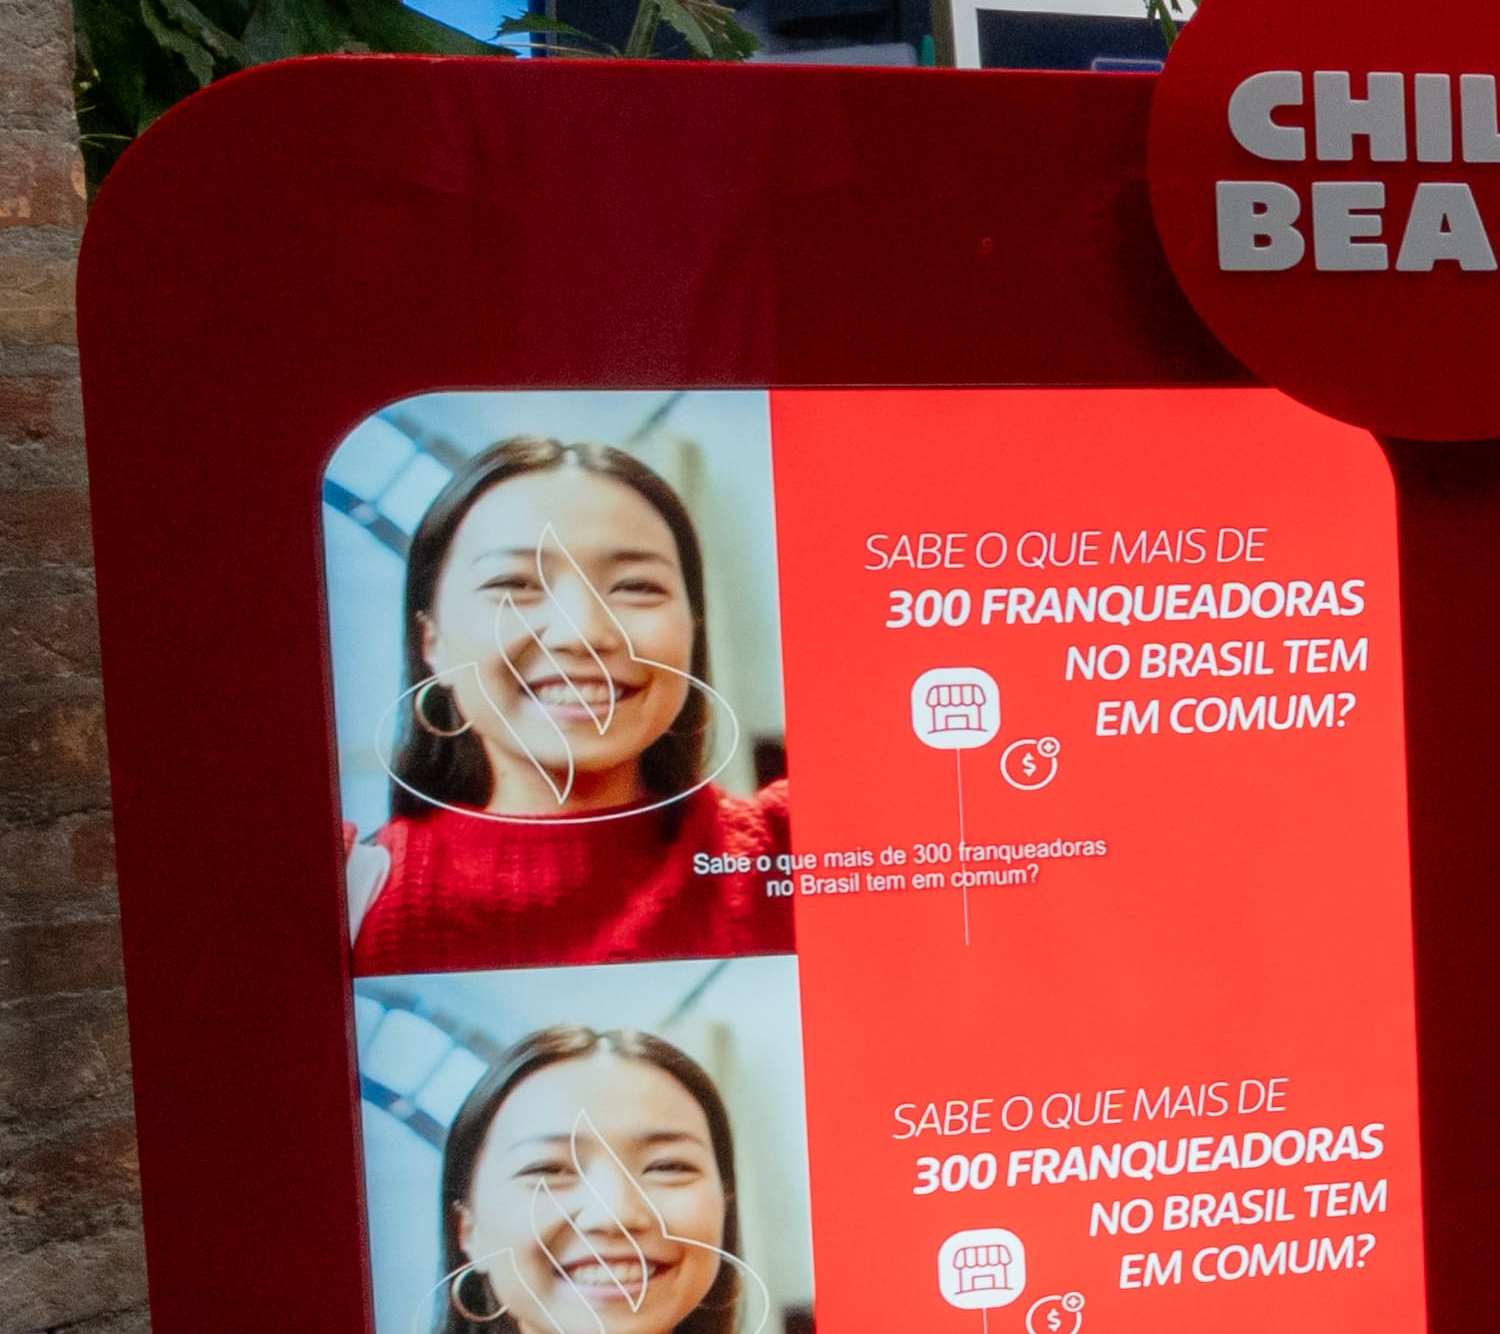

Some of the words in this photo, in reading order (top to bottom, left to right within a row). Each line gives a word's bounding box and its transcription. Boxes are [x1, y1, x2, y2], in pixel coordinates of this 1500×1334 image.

[865, 532, 968, 571] SABE
[975, 531, 1008, 568] O
[1016, 530, 1101, 570] QUE
[1108, 528, 1208, 566] MAIS
[1214, 527, 1269, 564] DE
[885, 588, 971, 629] 300
[981, 578, 1367, 627] FRANQUEADORAS
[1064, 644, 1131, 682] NO
[1139, 640, 1274, 680] BRASIL
[1283, 637, 1369, 674] TEM
[1095, 700, 1160, 738] EM
[1169, 692, 1357, 734] COMUM?
[692, 850, 750, 876] Sabe
[756, 855, 771, 872] o
[776, 852, 817, 877] que
[823, 846, 875, 868] mais
[879, 844, 907, 867] de
[912, 842, 952, 865] 300
[958, 836, 1108, 864] franqueadoras
[766, 877, 794, 898] no
[800, 872, 861, 896] Brasil
[866, 871, 907, 892] tem
[911, 870, 946, 890] em
[950, 863, 1041, 888] comum?
[891, 1097, 995, 1141] SABE
[1000, 1095, 1034, 1131] O
[1041, 1088, 1126, 1131] QUE
[1132, 1081, 1230, 1123] MAIS
[1237, 1077, 1290, 1115] DE
[912, 1152, 998, 1197] 300
[1006, 1122, 1386, 1188] FRANQUEADORAS
[1088, 1198, 1154, 1238] NO
[1162, 1188, 1296, 1233] BRASIL
[1303, 1178, 1389, 1219] TEM
[1119, 1250, 1184, 1290] EM
[1191, 1233, 1377, 1283] COMUM?
